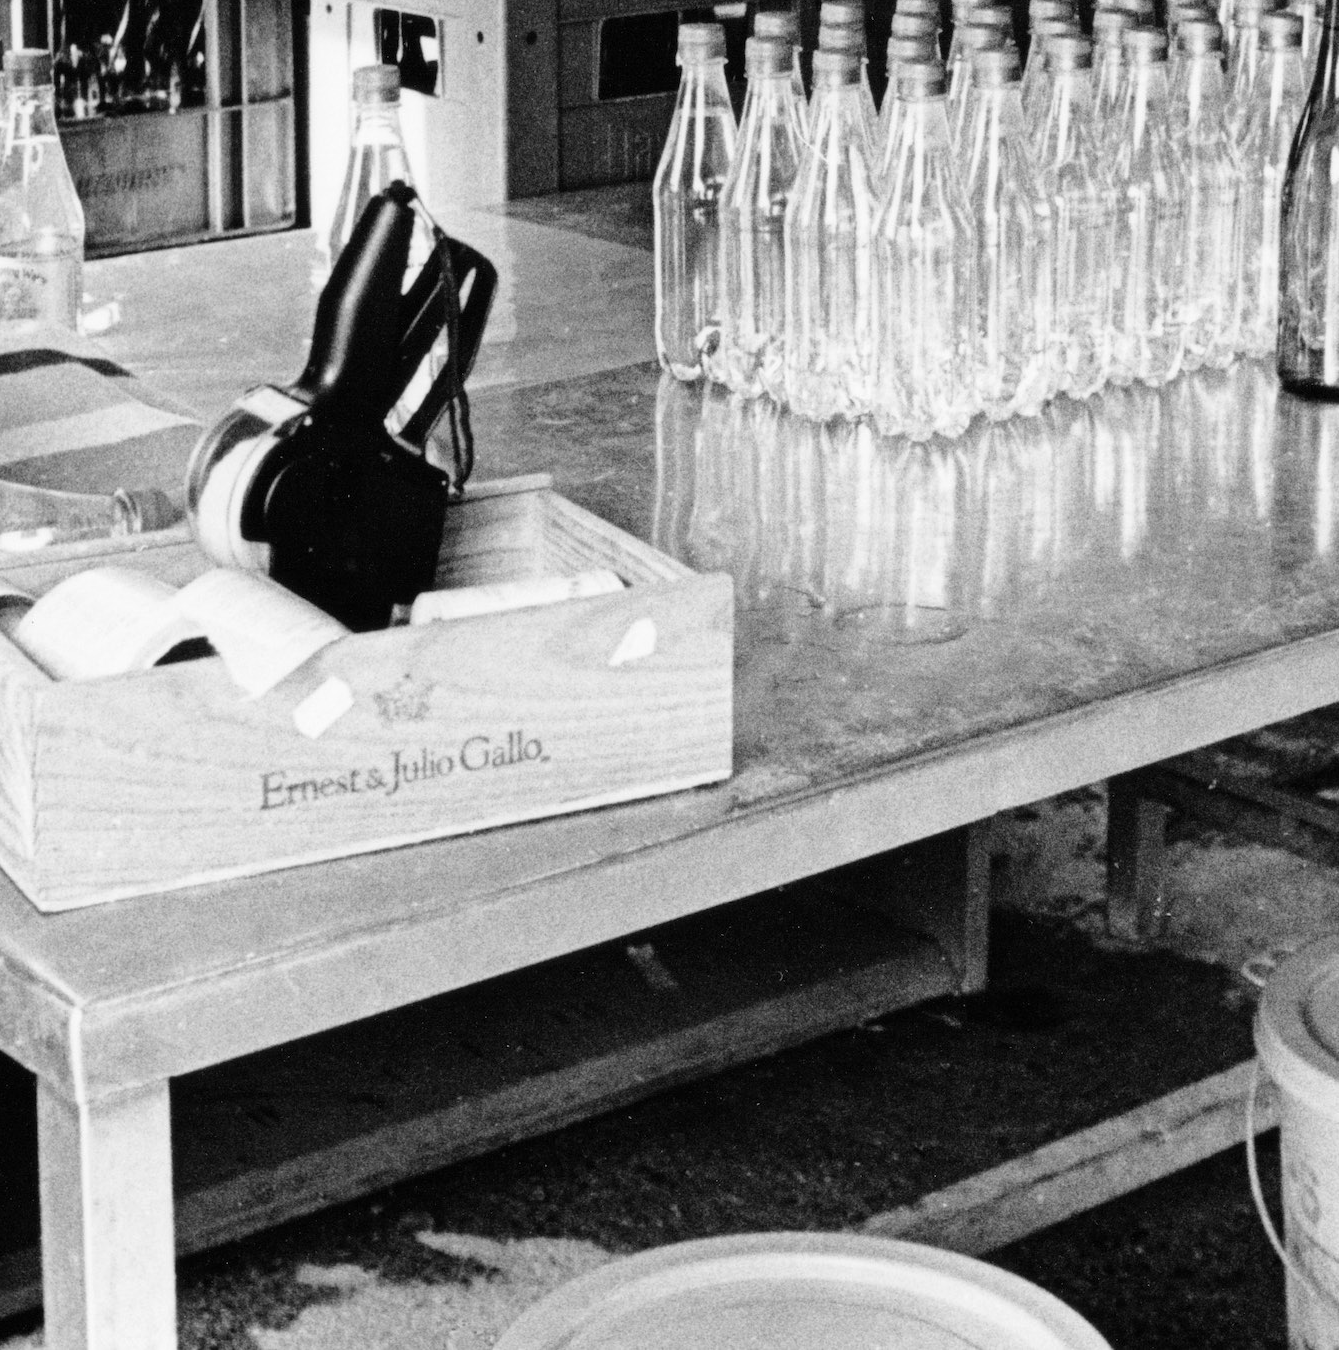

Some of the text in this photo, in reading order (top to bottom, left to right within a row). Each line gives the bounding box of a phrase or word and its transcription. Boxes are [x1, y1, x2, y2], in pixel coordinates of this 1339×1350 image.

[259, 769, 362, 811] Ernest
[364, 767, 387, 792] &
[385, 746, 455, 796] Julio
